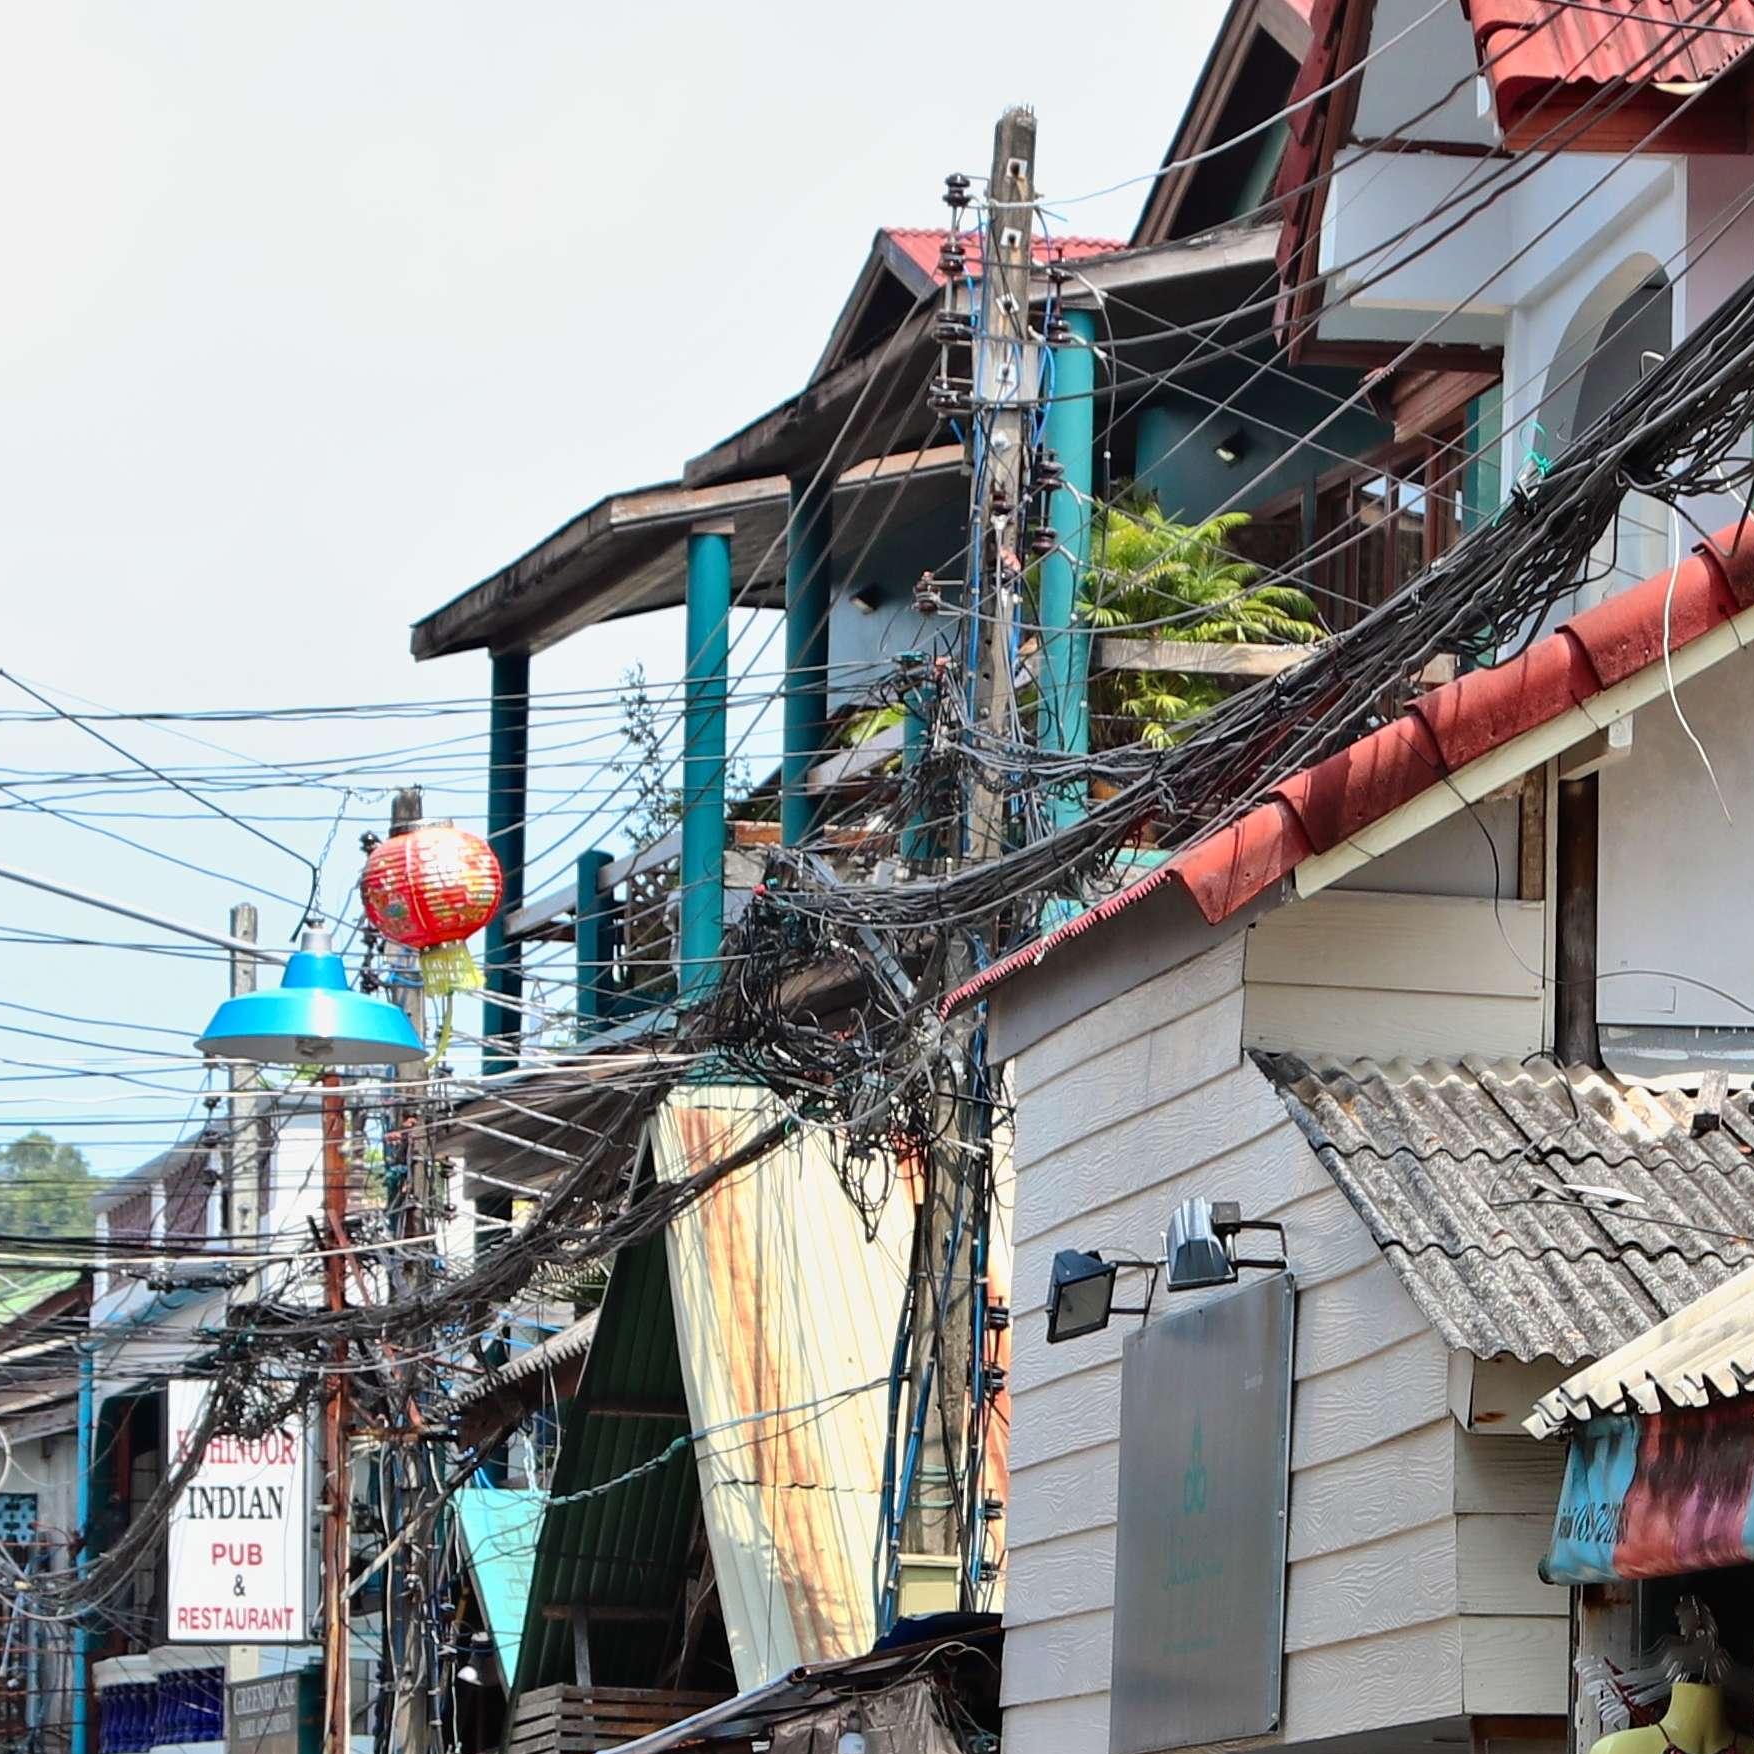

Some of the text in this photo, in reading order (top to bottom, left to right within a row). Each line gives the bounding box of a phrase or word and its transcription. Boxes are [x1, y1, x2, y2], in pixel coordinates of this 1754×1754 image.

[187, 1486, 284, 1520] INDIAN
[211, 1543, 263, 1566] PUB
[233, 1574, 246, 1597] &
[177, 1607, 294, 1631] RESTAURANT
